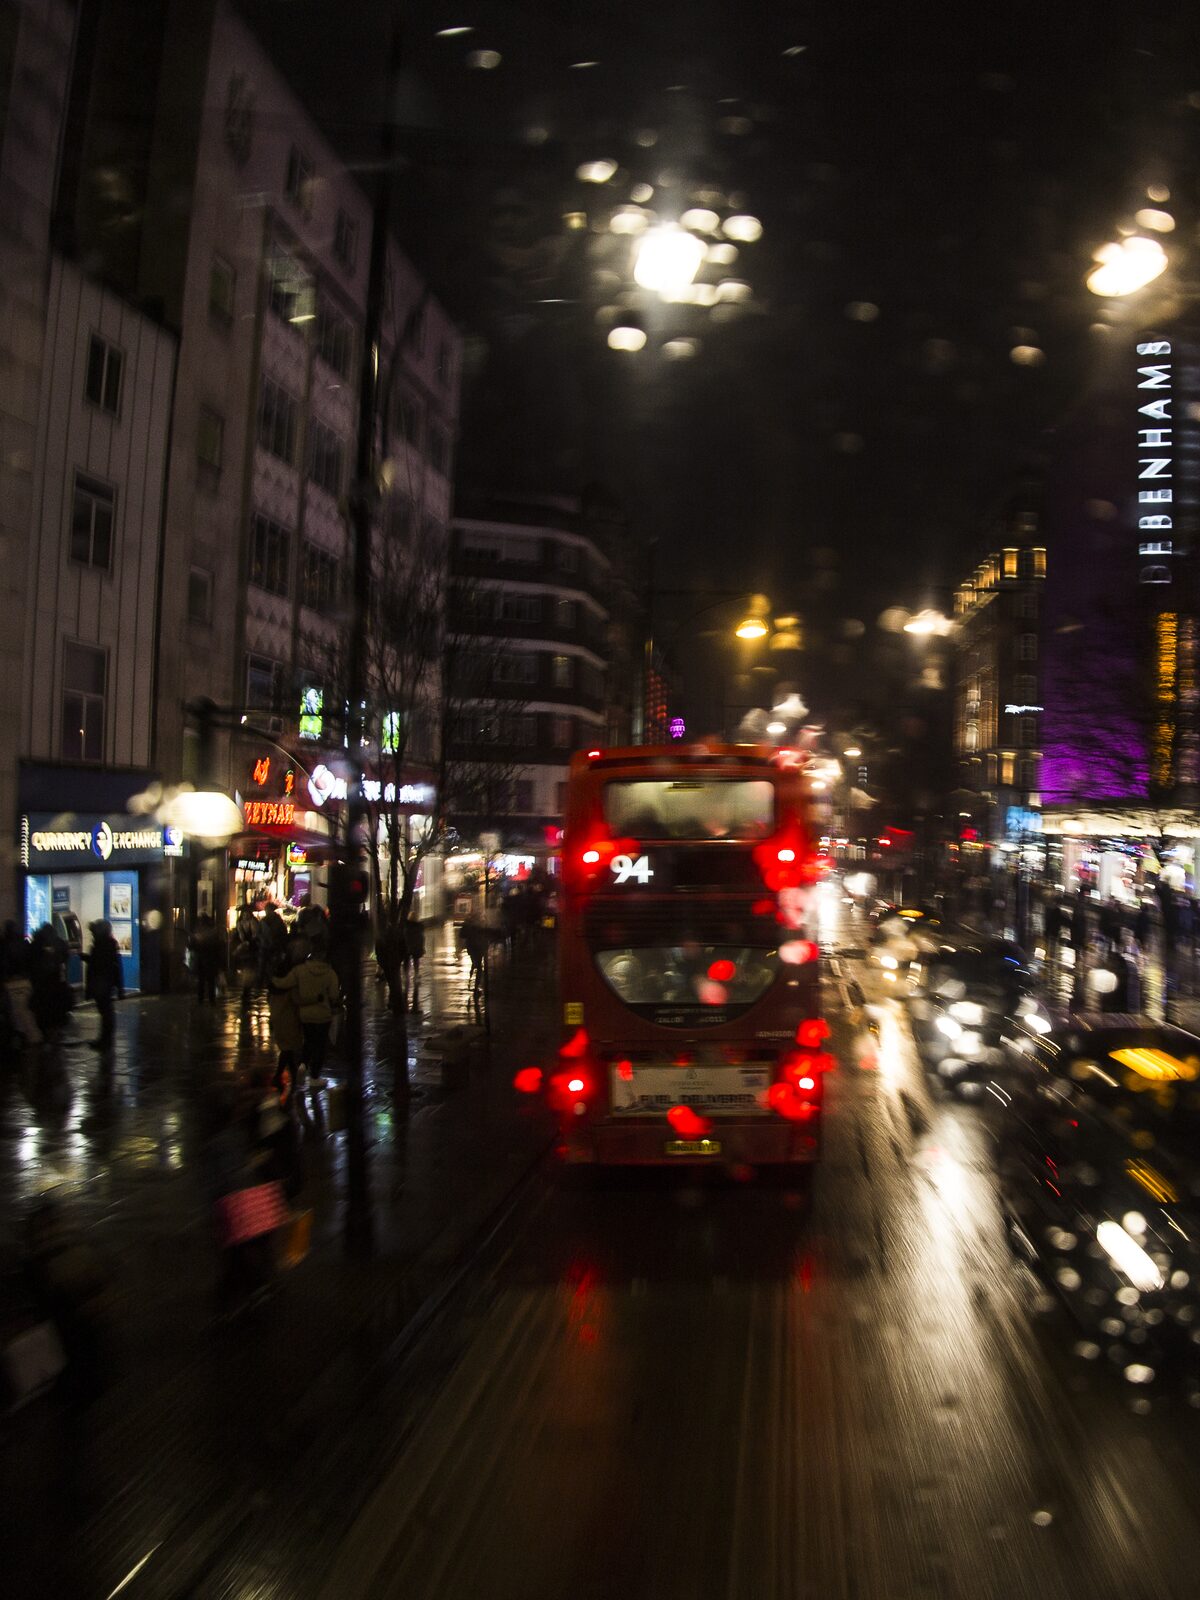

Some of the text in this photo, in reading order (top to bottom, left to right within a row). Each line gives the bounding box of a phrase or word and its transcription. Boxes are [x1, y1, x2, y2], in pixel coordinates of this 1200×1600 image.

[1136, 340, 1173, 584] DEBENHAMS
[31, 831, 162, 851] CURRENCY EXCHANGE
[609, 855, 654, 884] 94
